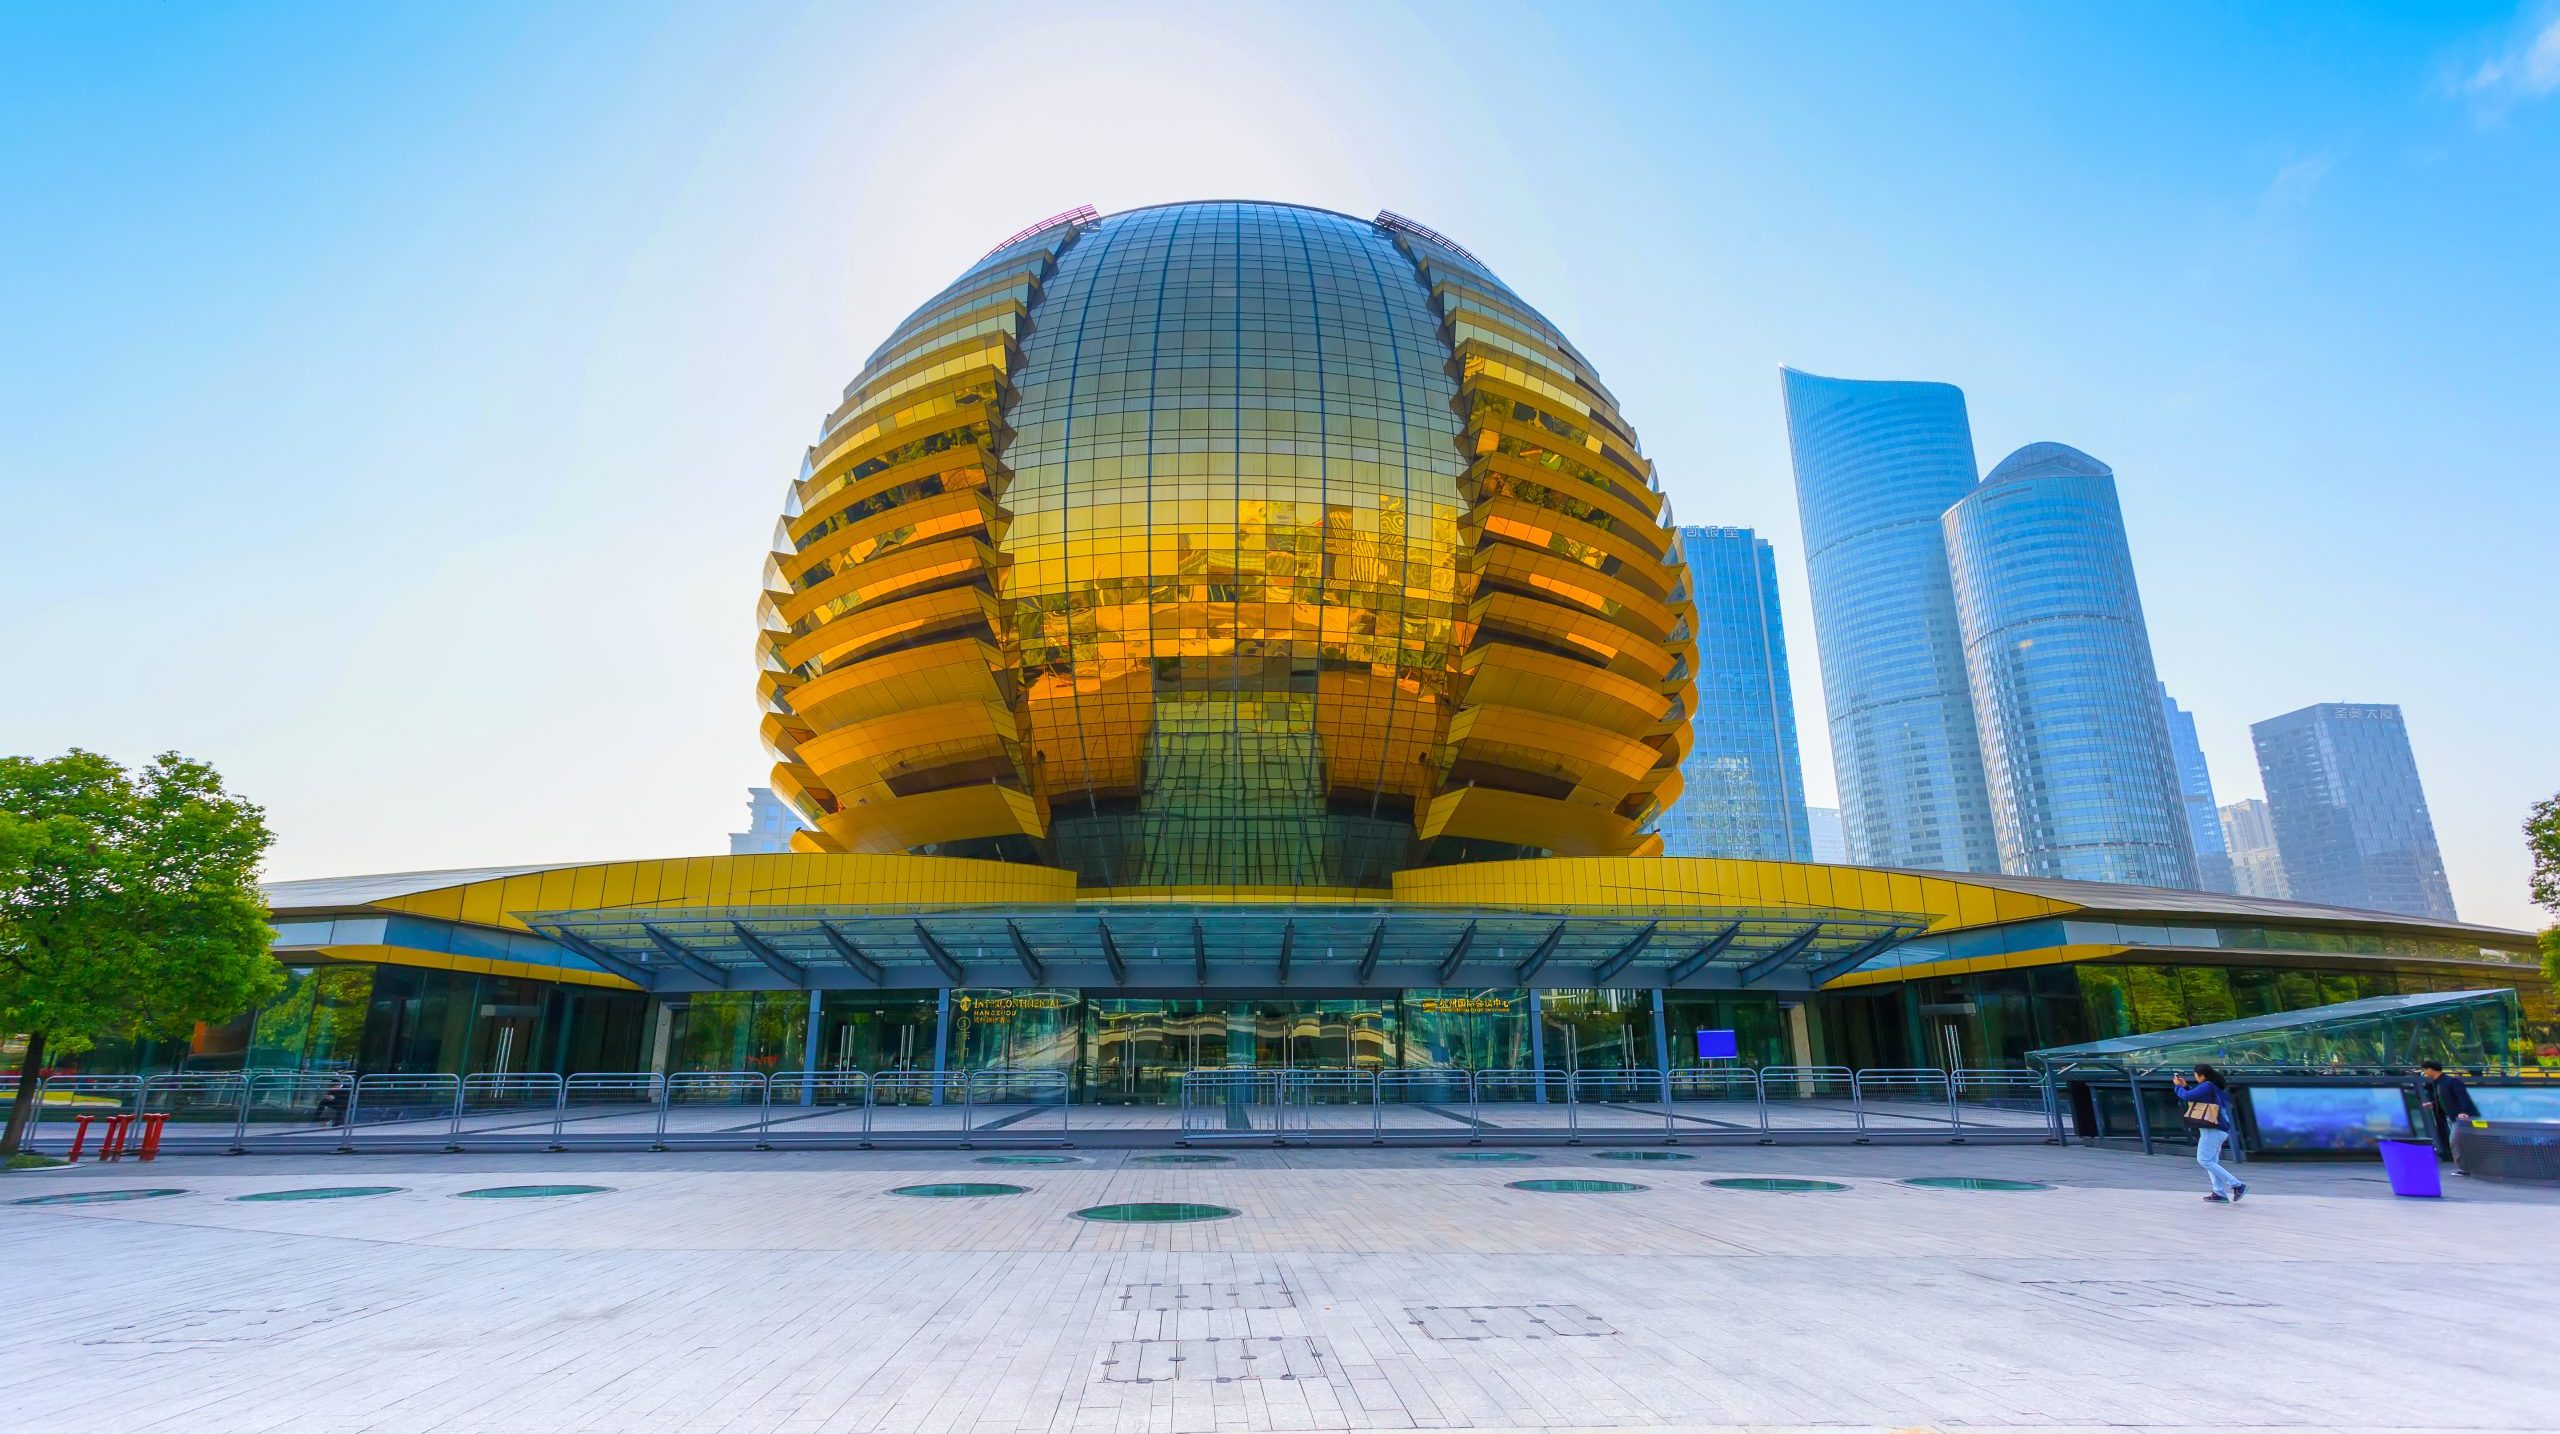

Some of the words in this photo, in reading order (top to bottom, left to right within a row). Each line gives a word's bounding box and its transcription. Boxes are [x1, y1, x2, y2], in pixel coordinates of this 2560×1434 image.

[1678, 525, 1740, 538] 凯银座
[1439, 998, 1509, 1008] 杭州国际会议中心
